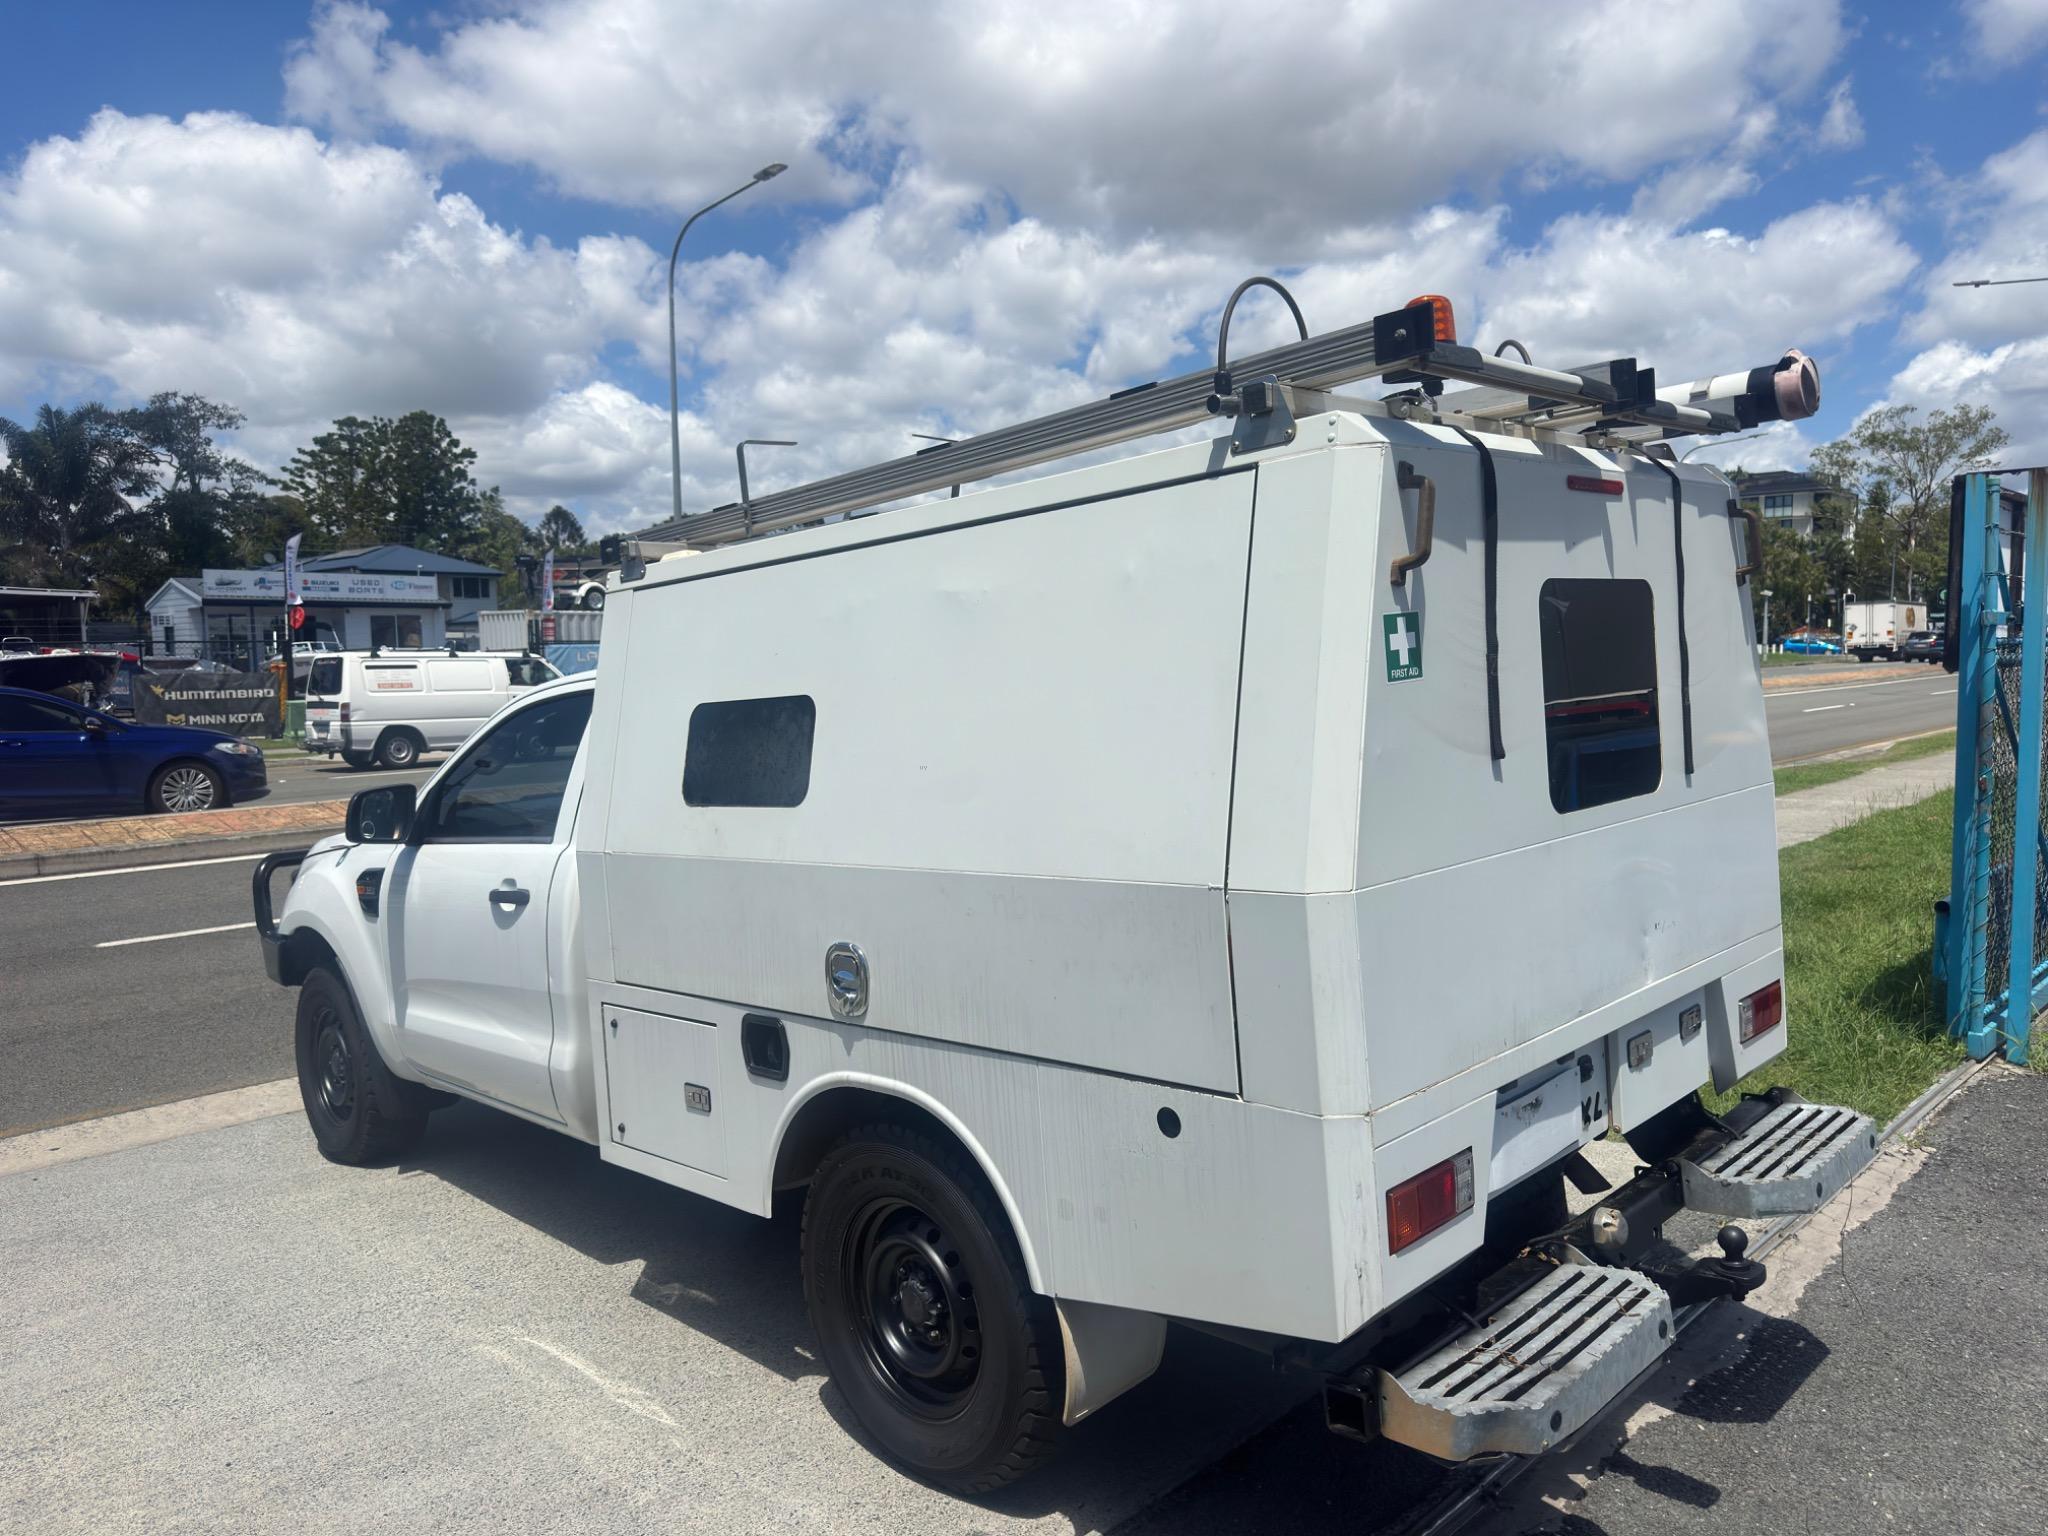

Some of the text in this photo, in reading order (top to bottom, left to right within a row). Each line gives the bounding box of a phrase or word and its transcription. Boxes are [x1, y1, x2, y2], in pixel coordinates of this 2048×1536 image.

[351, 579, 380, 587] USED
[348, 587, 385, 595] BOATS
[1391, 667, 1419, 679] FIRST AID
[188, 712, 265, 725] MINN KOTA
